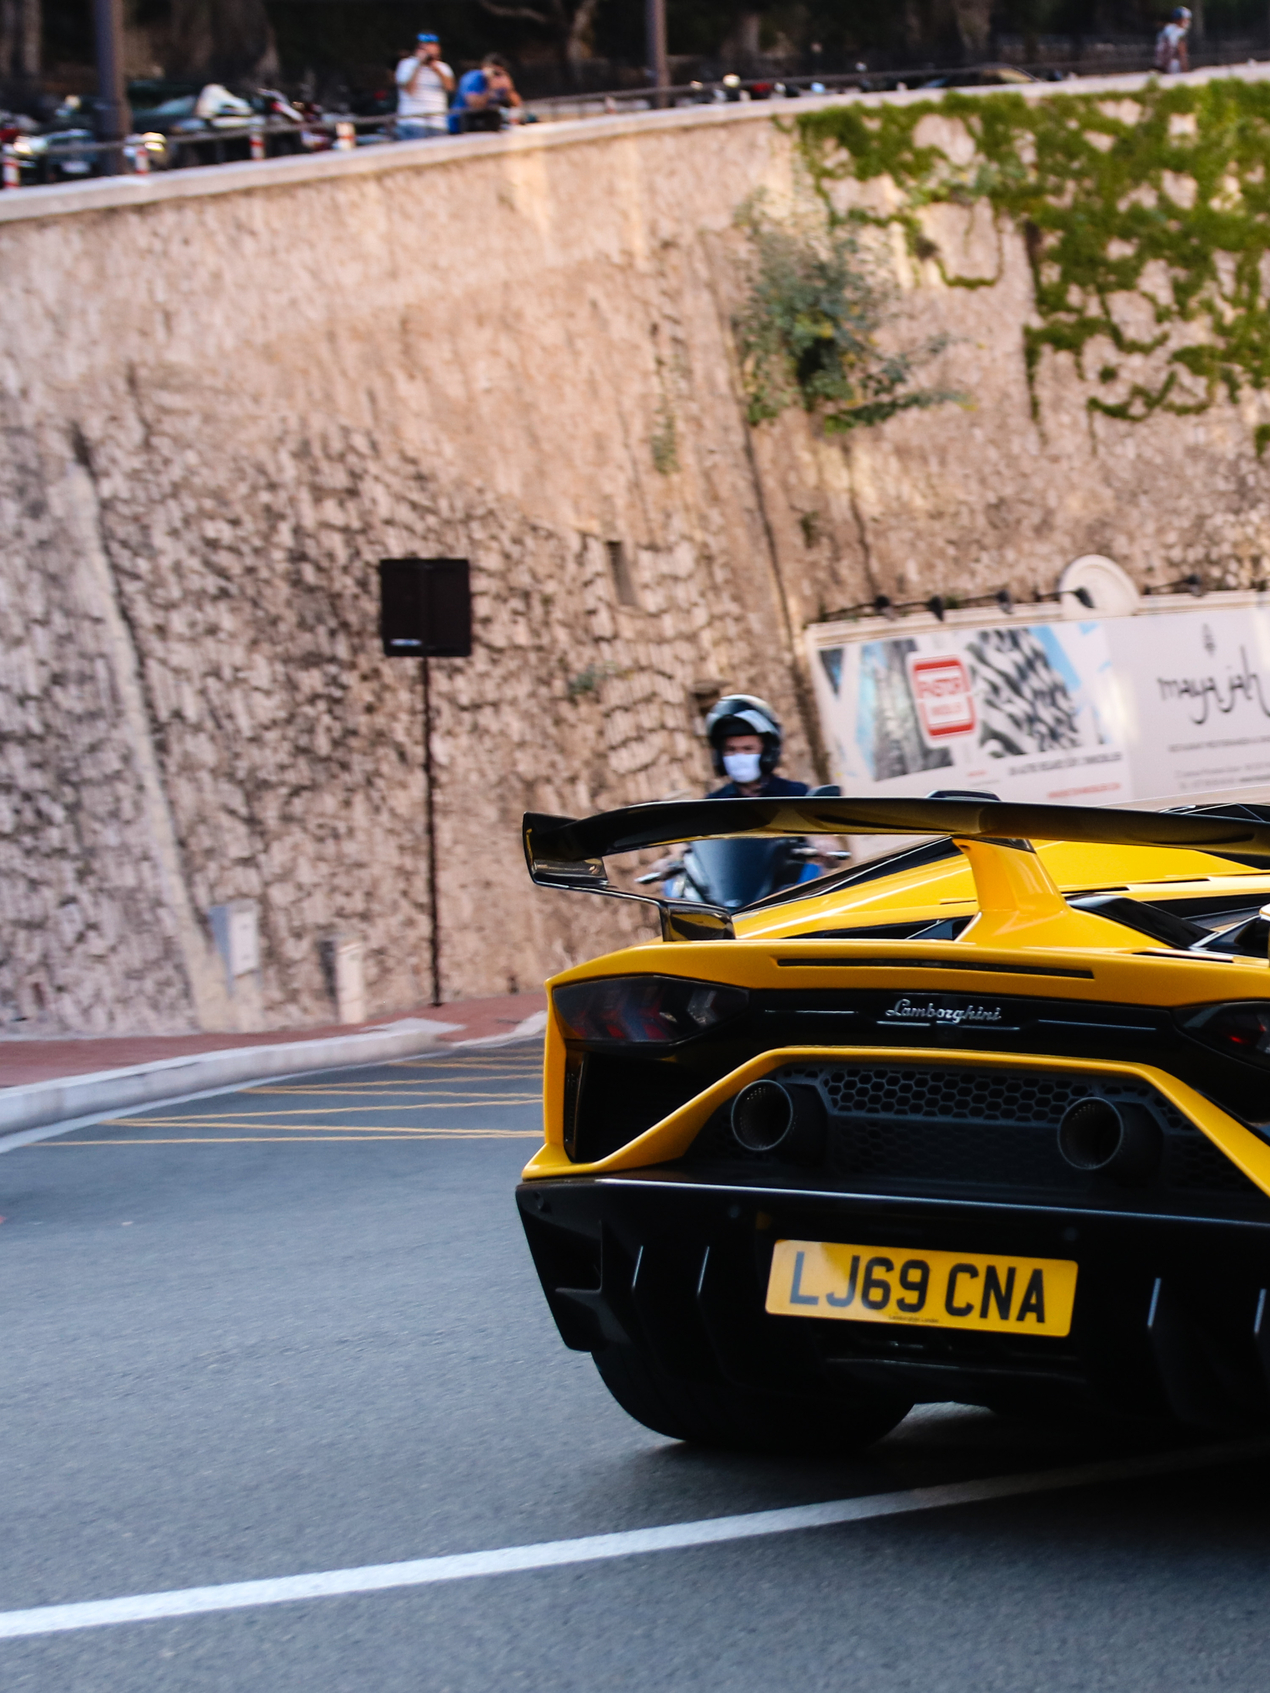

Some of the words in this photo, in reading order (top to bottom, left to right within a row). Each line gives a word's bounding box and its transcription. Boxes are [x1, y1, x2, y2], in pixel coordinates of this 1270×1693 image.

[885, 998, 1002, 1023] Lamborghini
[789, 1250, 930, 1313] LJ69
[944, 1262, 1046, 1324] CNA
